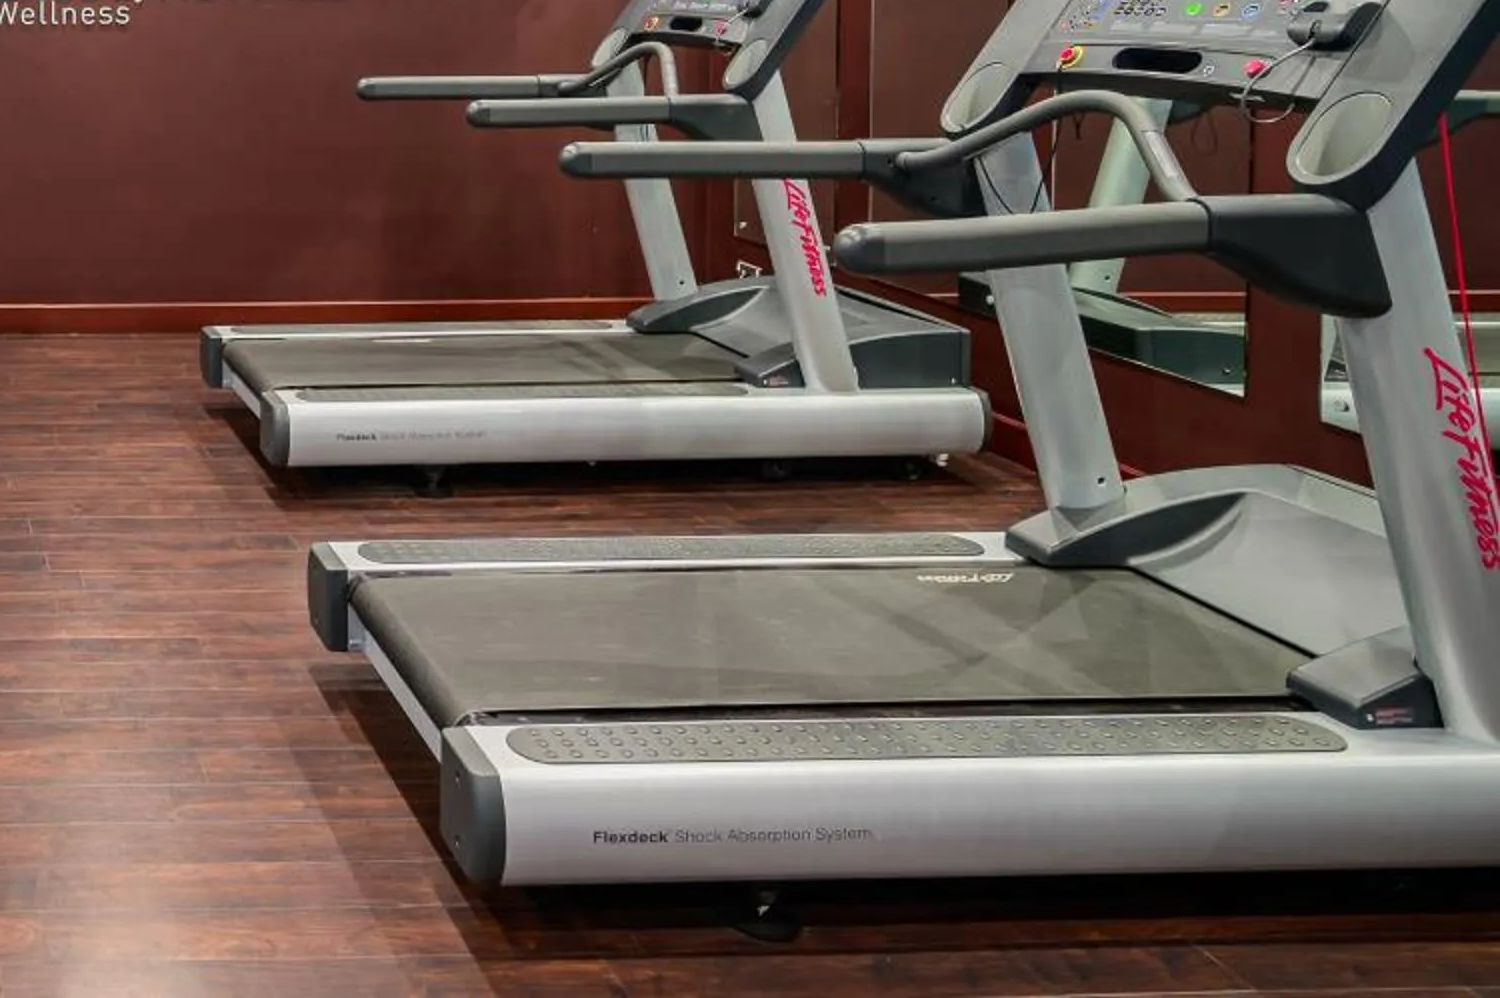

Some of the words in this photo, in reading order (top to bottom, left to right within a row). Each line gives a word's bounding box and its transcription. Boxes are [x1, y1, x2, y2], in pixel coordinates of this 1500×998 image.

[593, 830, 669, 844] Flexdeck
[674, 827, 722, 843] Shock
[727, 827, 812, 844] Absorption
[815, 826, 873, 845] System
